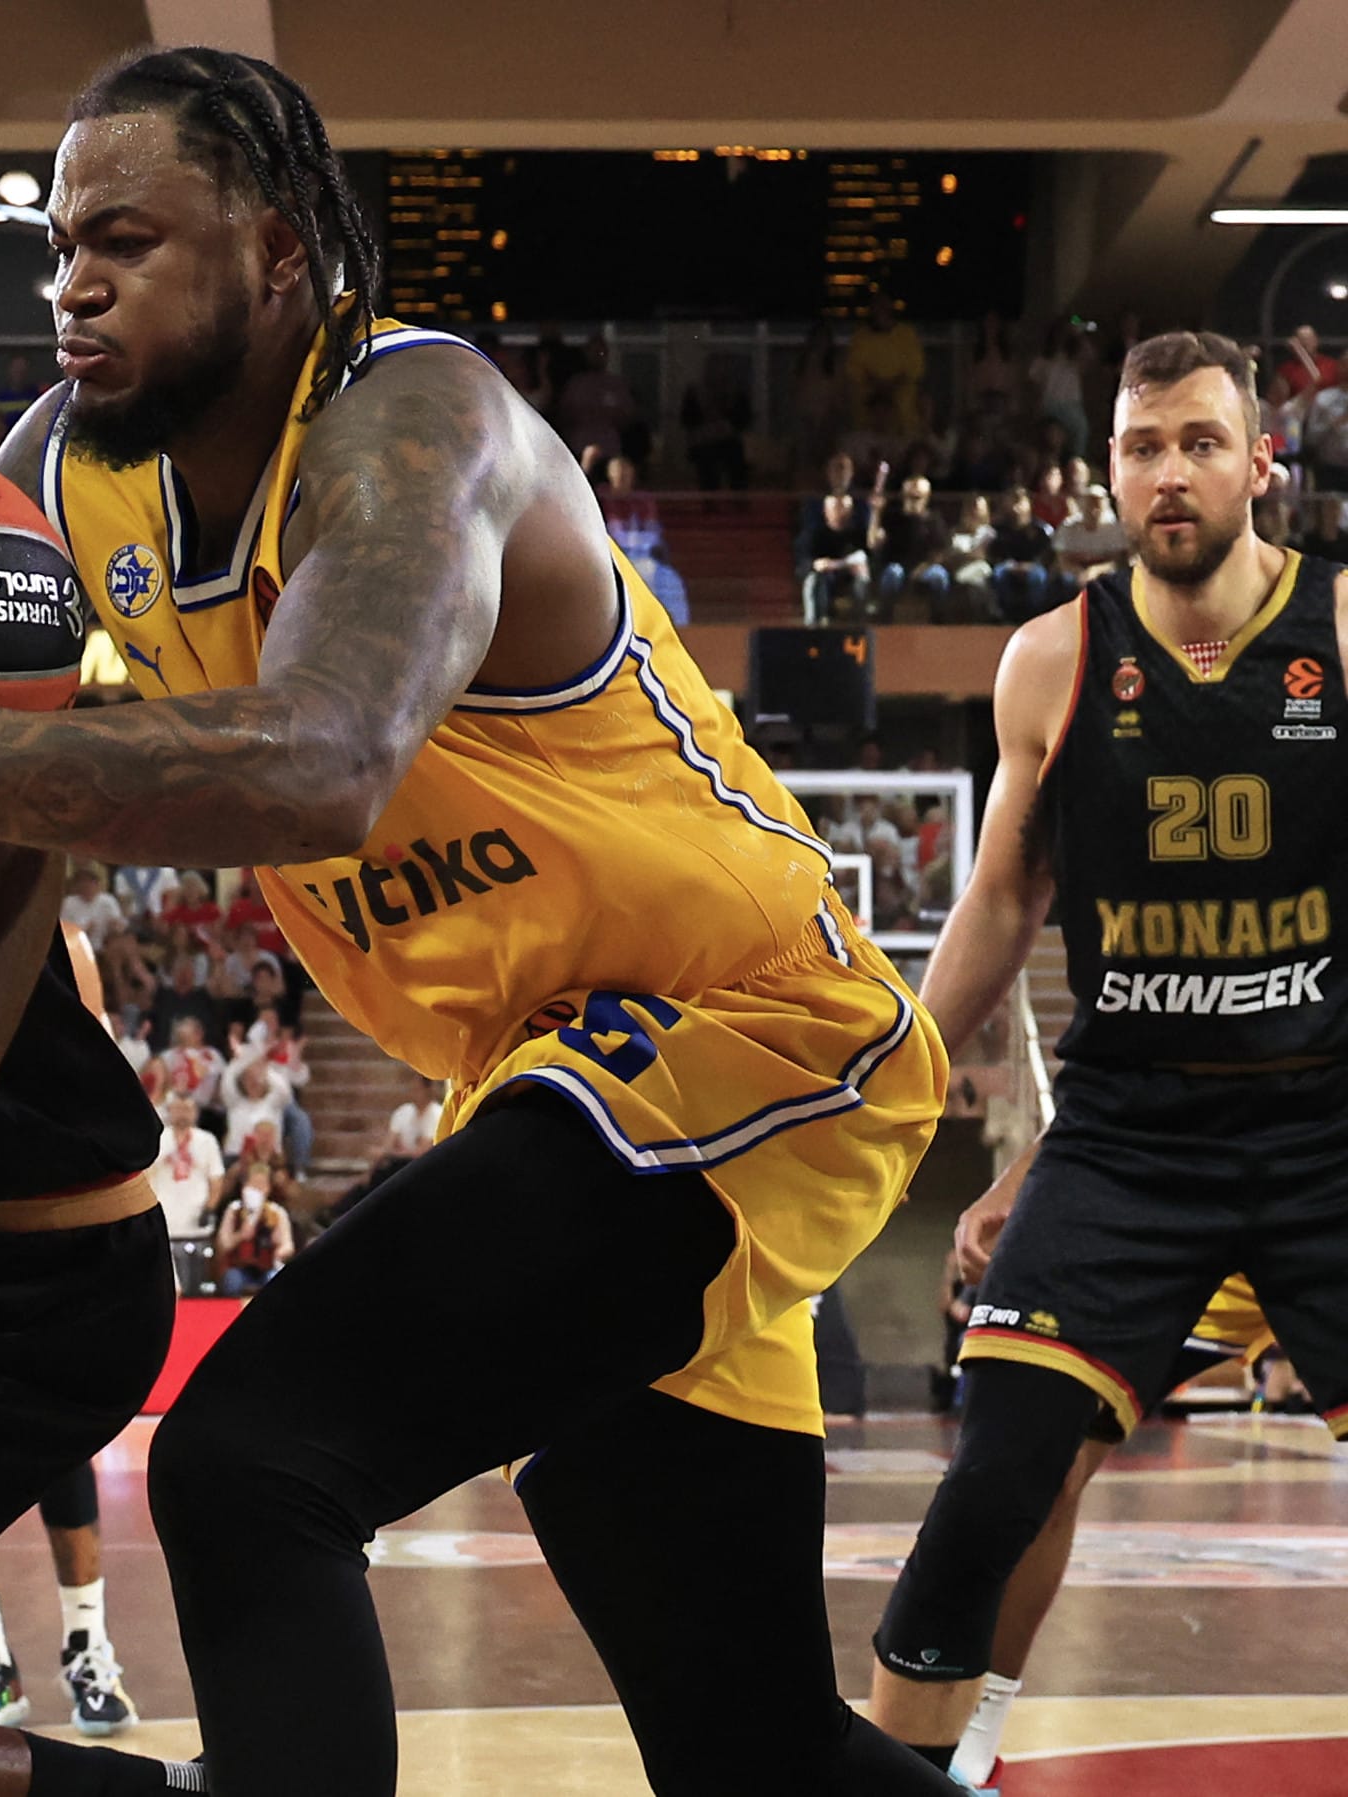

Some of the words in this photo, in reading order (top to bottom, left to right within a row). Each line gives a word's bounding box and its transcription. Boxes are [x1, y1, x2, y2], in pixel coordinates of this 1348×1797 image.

[1147, 774, 1271, 861] 20
[1096, 886, 1332, 958] MONACO
[1096, 956, 1332, 1015] SKWEEK
